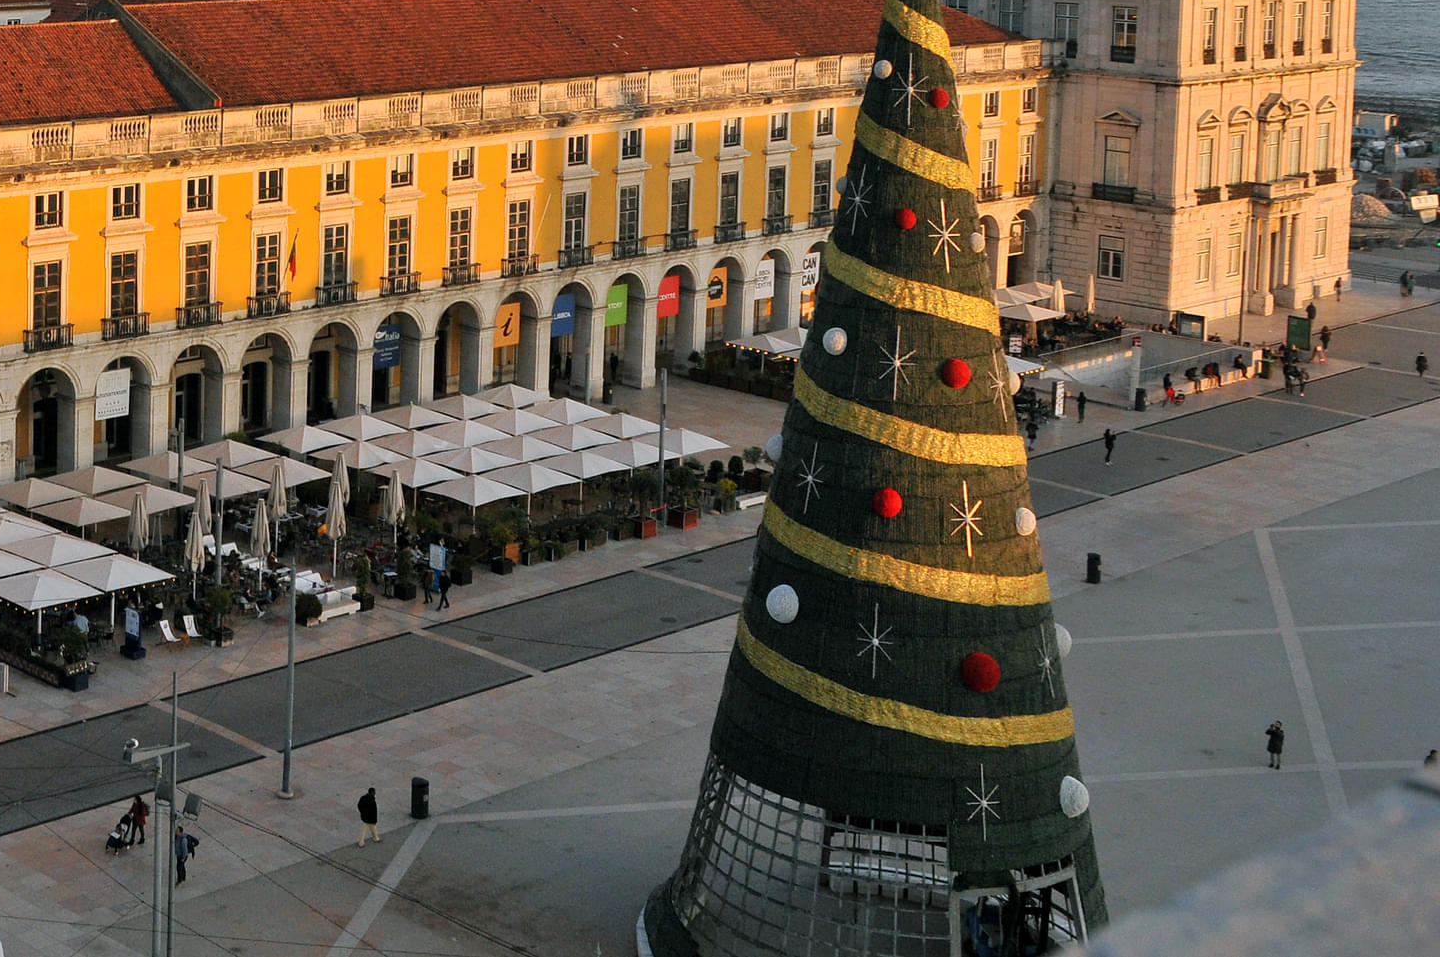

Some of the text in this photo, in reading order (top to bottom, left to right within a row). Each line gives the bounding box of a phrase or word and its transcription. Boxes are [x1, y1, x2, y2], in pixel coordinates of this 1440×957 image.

[802, 256, 817, 270] CAN
[801, 272, 816, 287] CAN
[658, 292, 676, 300] CENTRE
[553, 311, 571, 320] LISBOA
[500, 312, 513, 337] i
